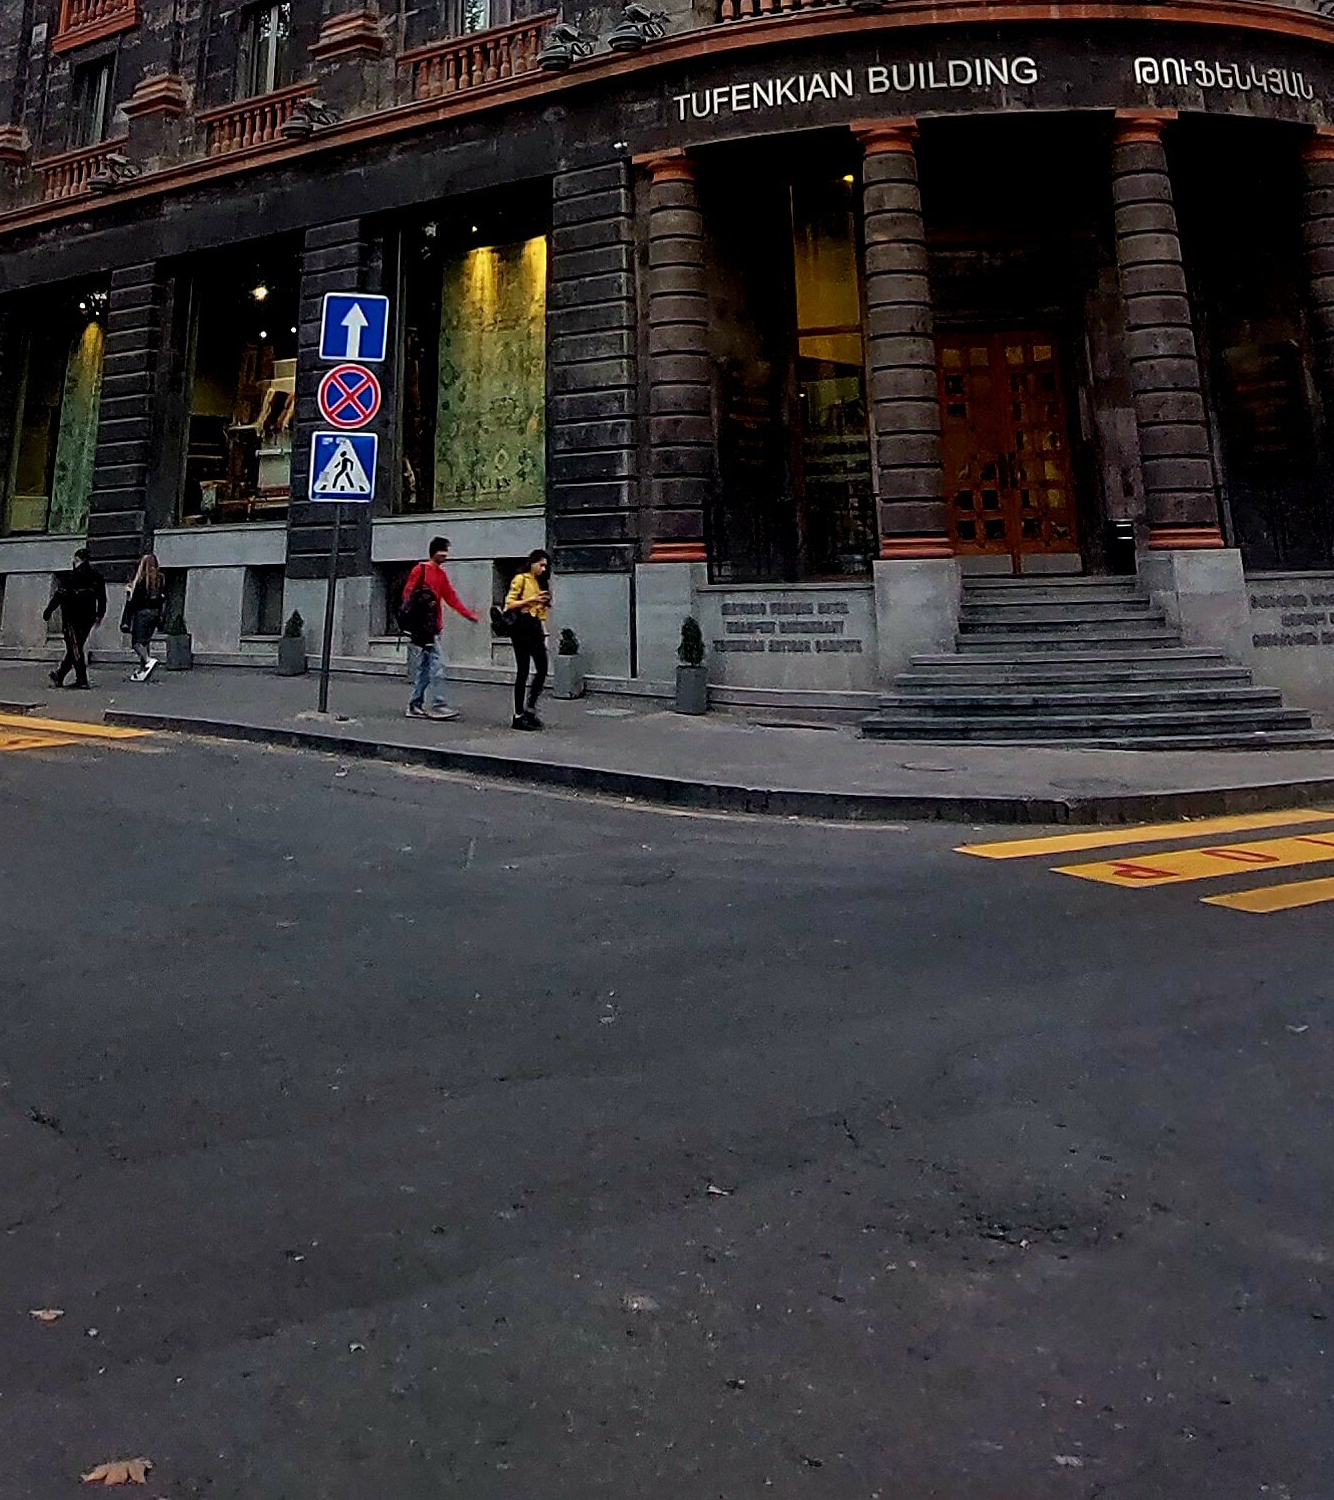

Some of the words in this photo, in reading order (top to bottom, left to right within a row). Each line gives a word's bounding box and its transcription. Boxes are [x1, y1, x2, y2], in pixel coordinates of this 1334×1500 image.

[673, 69, 854, 121] TUFENKIAN
[867, 56, 1038, 94] BUILDING
[1134, 56, 1314, 100] ԹՈՒՖԵՆԿՅԱՆ
